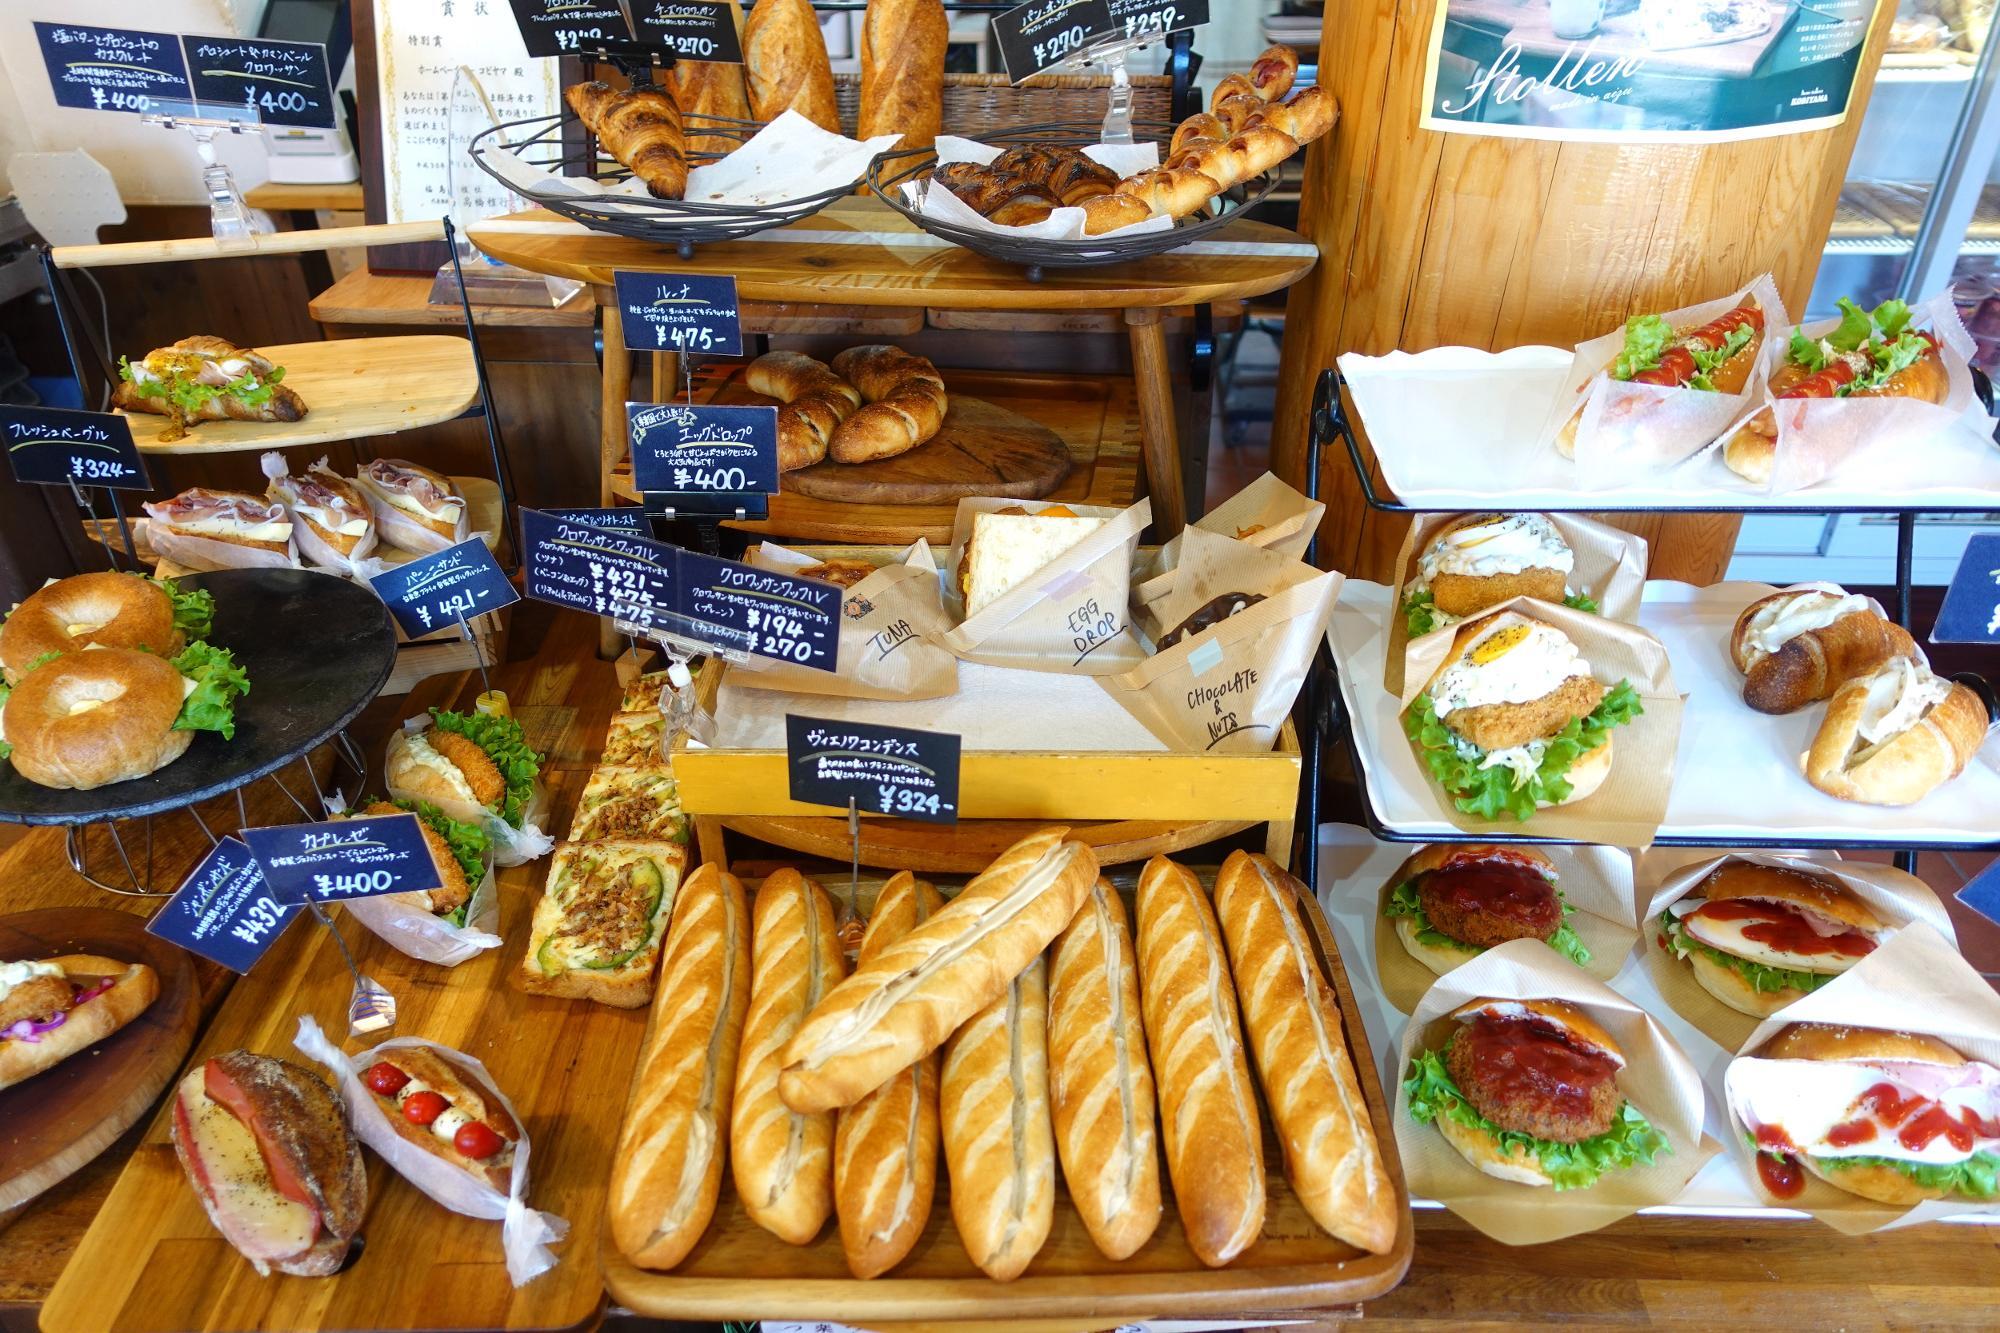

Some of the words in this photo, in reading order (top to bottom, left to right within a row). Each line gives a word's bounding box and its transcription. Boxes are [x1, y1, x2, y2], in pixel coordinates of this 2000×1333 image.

[1125, 6, 1185, 39] ¥259-
[1033, 25, 1093, 67] ¥270-
[244, 61, 308, 76] クロワッサン
[1442, 35, 1646, 114] Stollen
[90, 87, 160, 110] ¥400-
[245, 85, 319, 114] ¥400-
[656, 283, 690, 300] ルーナ
[655, 325, 726, 350] ¥475-
[9, 423, 110, 441] フレッシュベーグル
[679, 423, 753, 442] エッグドロップ
[70, 456, 136, 478] ¥324-
[673, 467, 757, 490] ¥400-
[557, 524, 660, 561] クロワッサンワッフル
[589, 562, 664, 590] ¥421-
[720, 567, 830, 604] クロワッサンワッフル
[416, 589, 490, 628] ¥421-
[593, 580, 668, 608] ¥475-
[595, 596, 668, 625] ¥475-
[694, 602, 735, 618] (プレーン)
[747, 608, 825, 639] ¥194-
[1067, 598, 1100, 634] EGG
[746, 630, 825, 661] ¥270-
[866, 618, 913, 655] TUNA
[1073, 611, 1116, 654] DROP
[1186, 667, 1259, 710] CHOCOLATE
[807, 729, 920, 757] ヴィエノワコンデンス
[878, 784, 954, 815] ¥324-
[300, 827, 370, 849] カプレーゼ
[313, 870, 402, 897] ¥400-
[231, 897, 288, 945] ¥432
